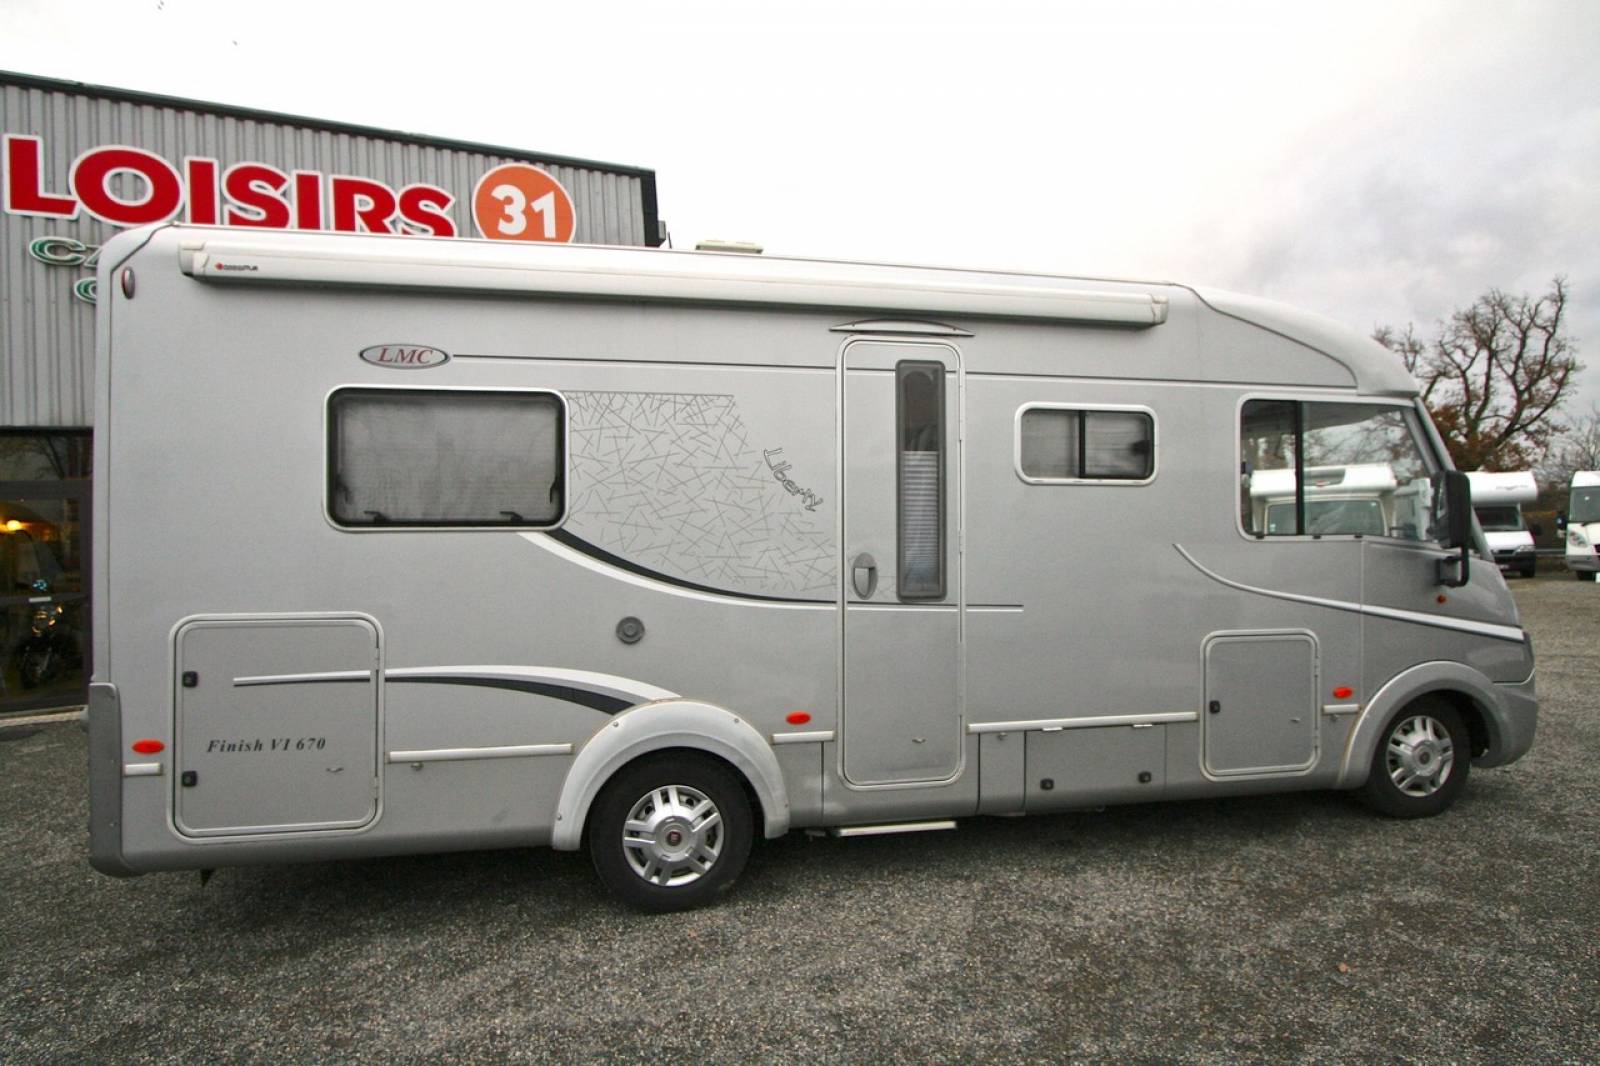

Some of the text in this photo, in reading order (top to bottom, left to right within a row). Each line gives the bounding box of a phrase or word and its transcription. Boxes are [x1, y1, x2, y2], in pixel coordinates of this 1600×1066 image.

[5, 134, 557, 239] LOISIRS 31
[378, 348, 433, 364] LMC
[207, 738, 264, 753] Finish
[296, 736, 326, 751] 670
